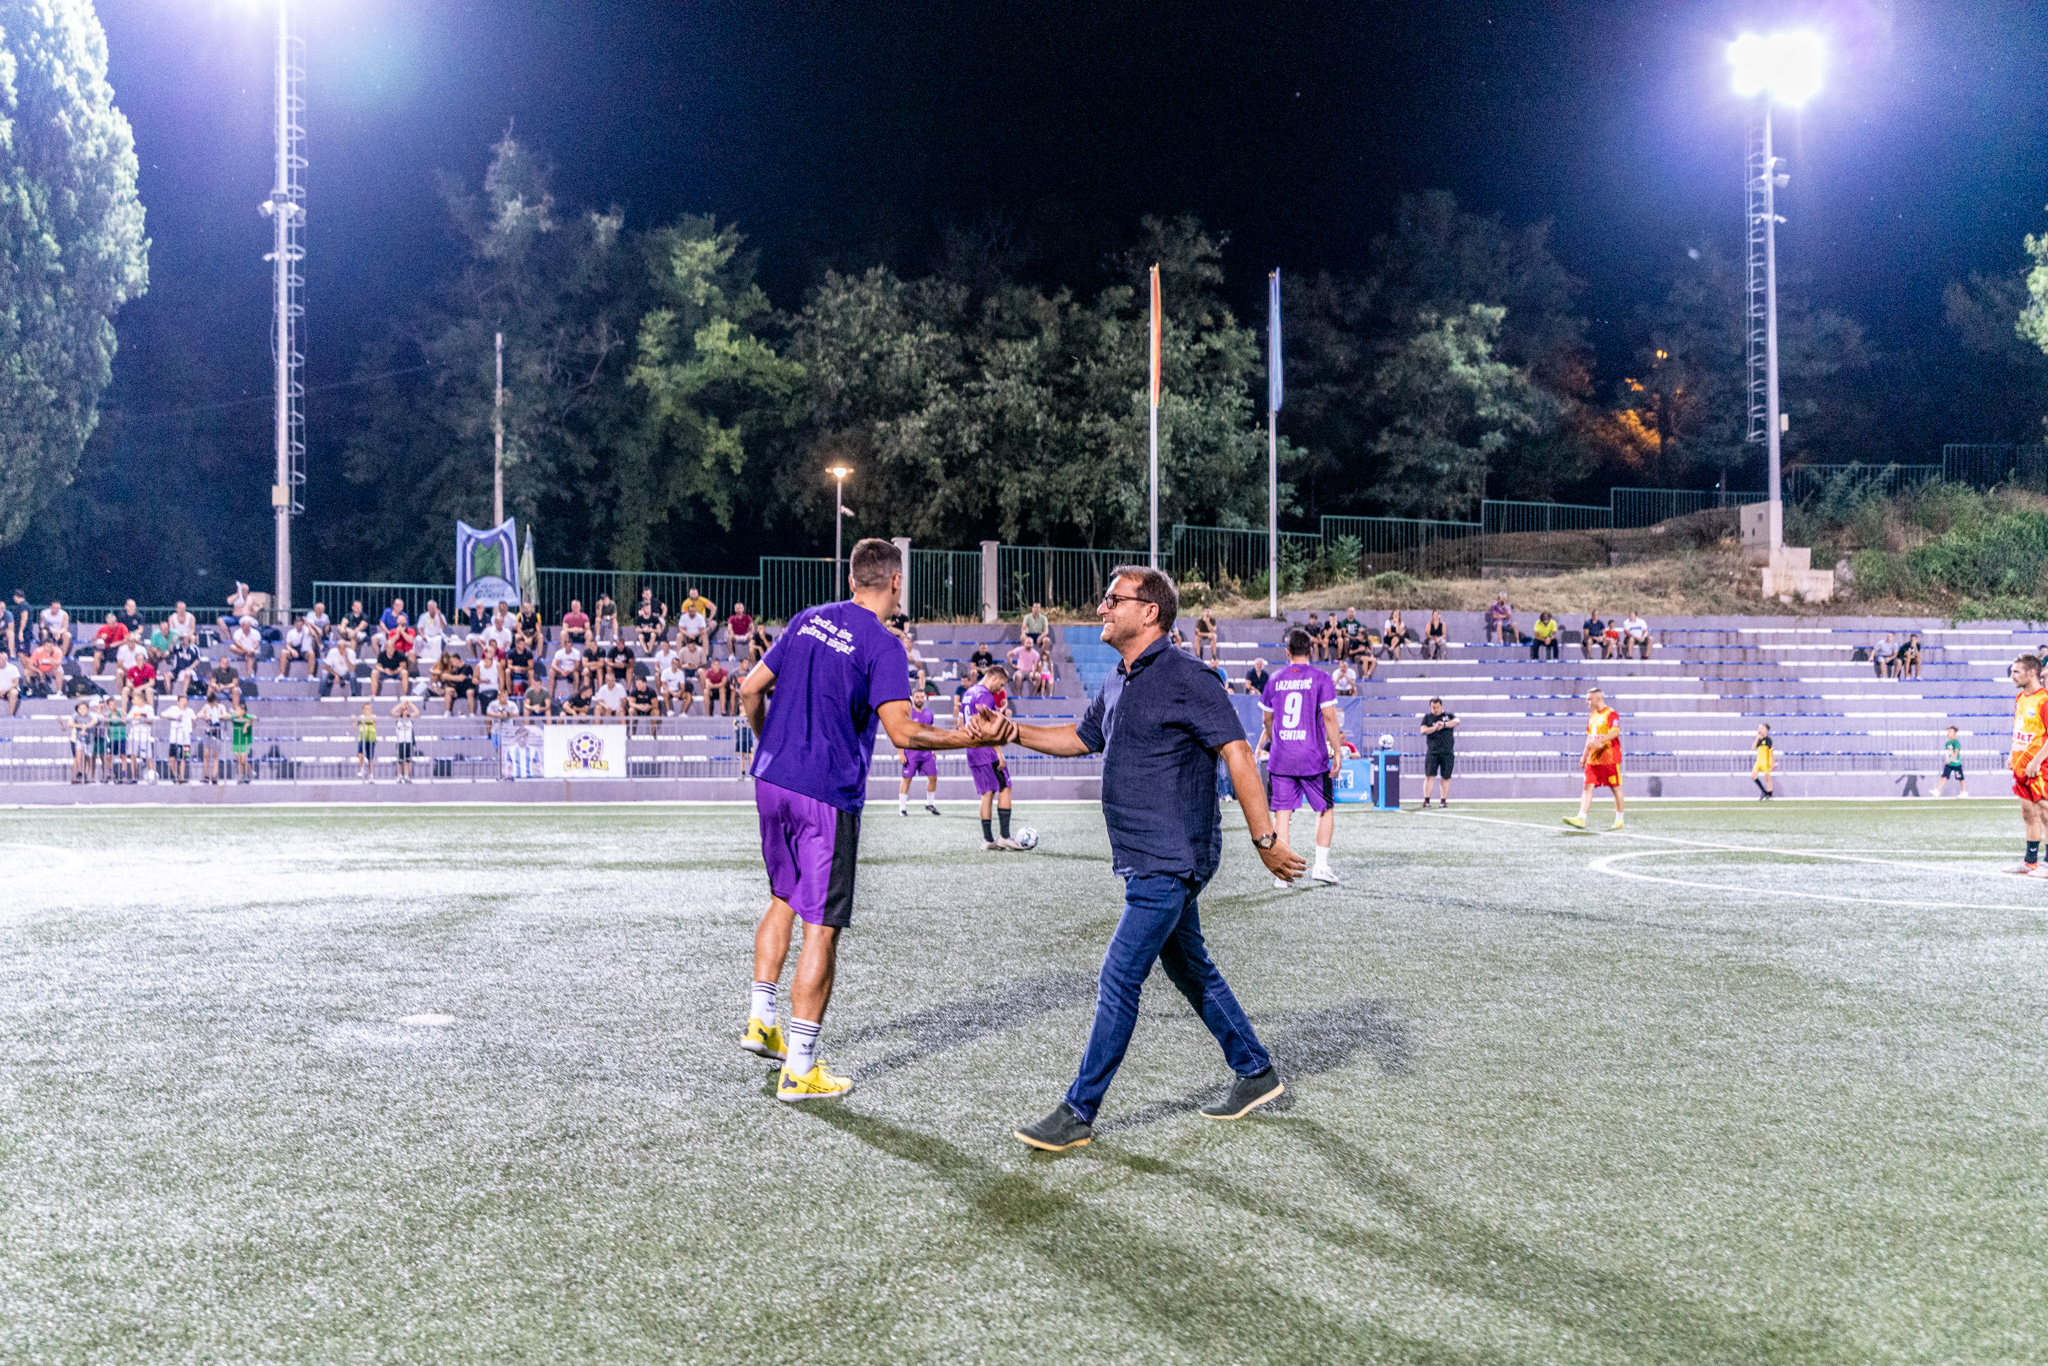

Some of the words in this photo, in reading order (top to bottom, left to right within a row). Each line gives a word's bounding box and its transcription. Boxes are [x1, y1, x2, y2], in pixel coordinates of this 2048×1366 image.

[1275, 677, 1313, 692] LAZAREVIĆ
[1282, 691, 1303, 729] 9
[1278, 729, 1307, 741] CENTAR
